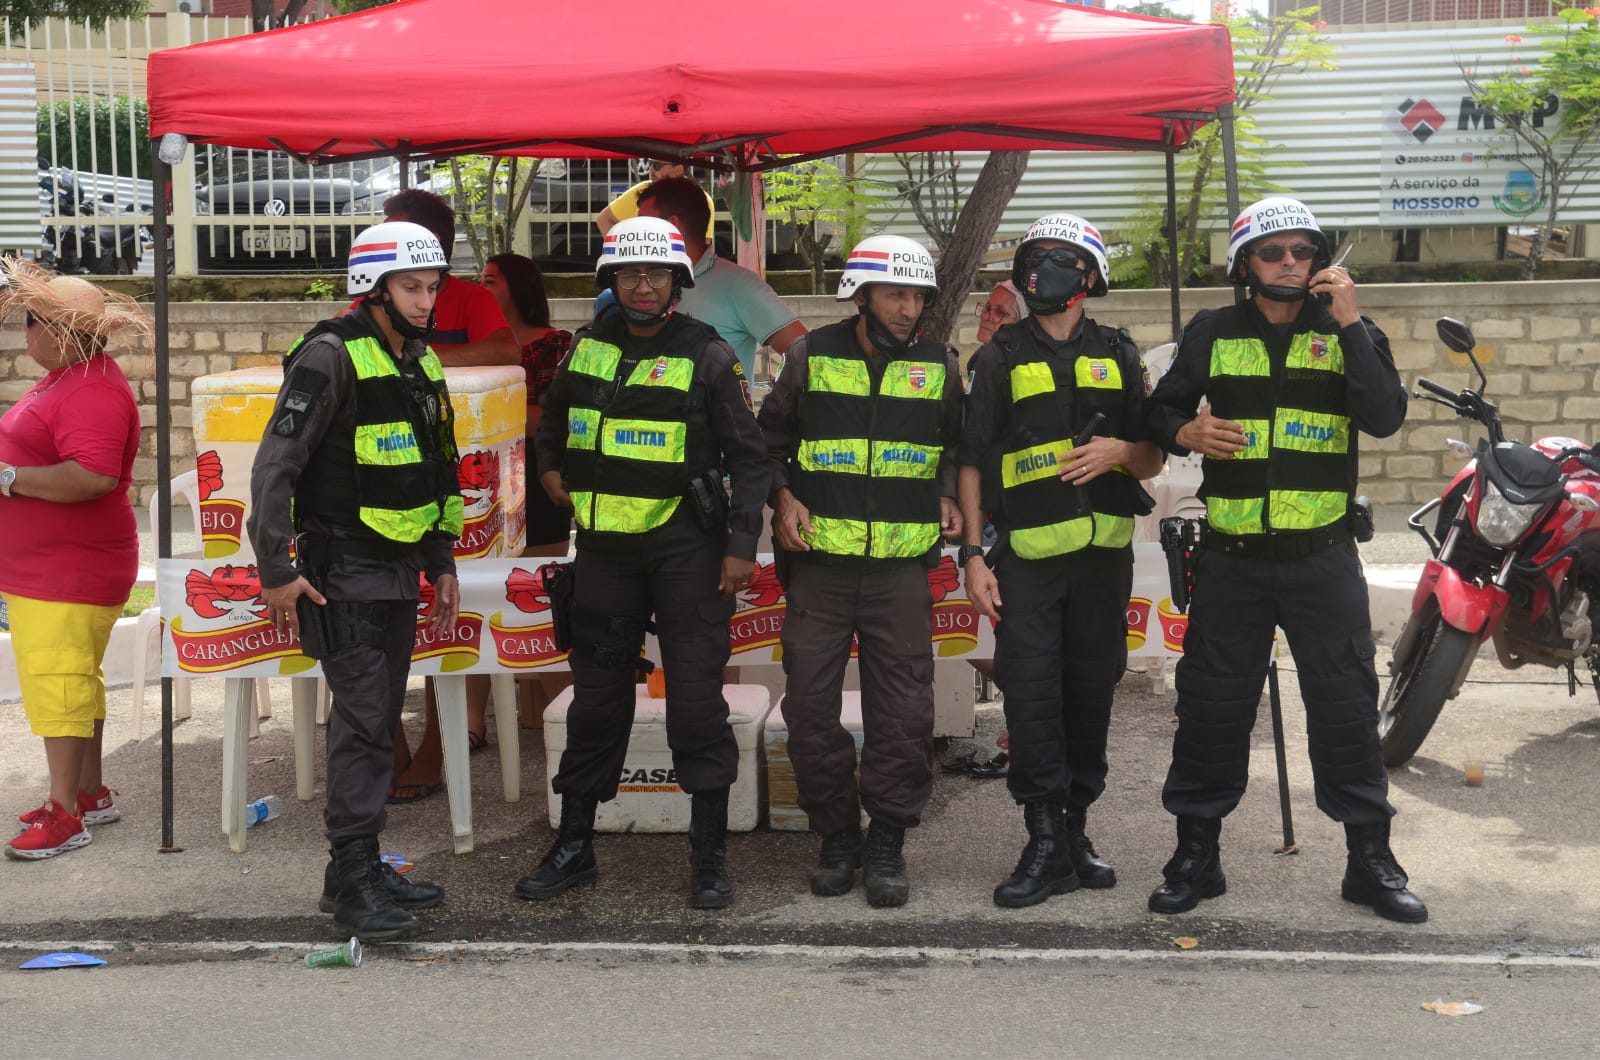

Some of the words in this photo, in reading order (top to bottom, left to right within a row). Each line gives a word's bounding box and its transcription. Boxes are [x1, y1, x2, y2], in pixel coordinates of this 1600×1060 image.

[1407, 155, 1456, 163] 2030-2323
[1390, 178, 1400, 190] A
[1404, 177, 1458, 190] serviço
[1462, 176, 1480, 188] da
[1256, 203, 1307, 222] POLÍCIA
[1406, 209, 1464, 217] PREFEITURA
[1260, 216, 1312, 233] MILITAR
[619, 230, 668, 244] POLÍCIA
[1030, 227, 1078, 241] MILITAR
[406, 236, 440, 252] POLÍC
[618, 245, 669, 257] MILITAR
[411, 252, 446, 265] MILITA
[893, 266, 935, 281] MILITAR
[569, 416, 588, 436] ÍCIA
[376, 431, 416, 453] POLÍCIA
[615, 429, 666, 447] MILITAR
[813, 448, 857, 466] POLÍCIA
[882, 448, 927, 465] MILITAR
[1015, 451, 1057, 476] POLÍCIA
[182, 628, 301, 660] CARANGUEJ
[619, 785, 676, 793] CONSTRUCTION
